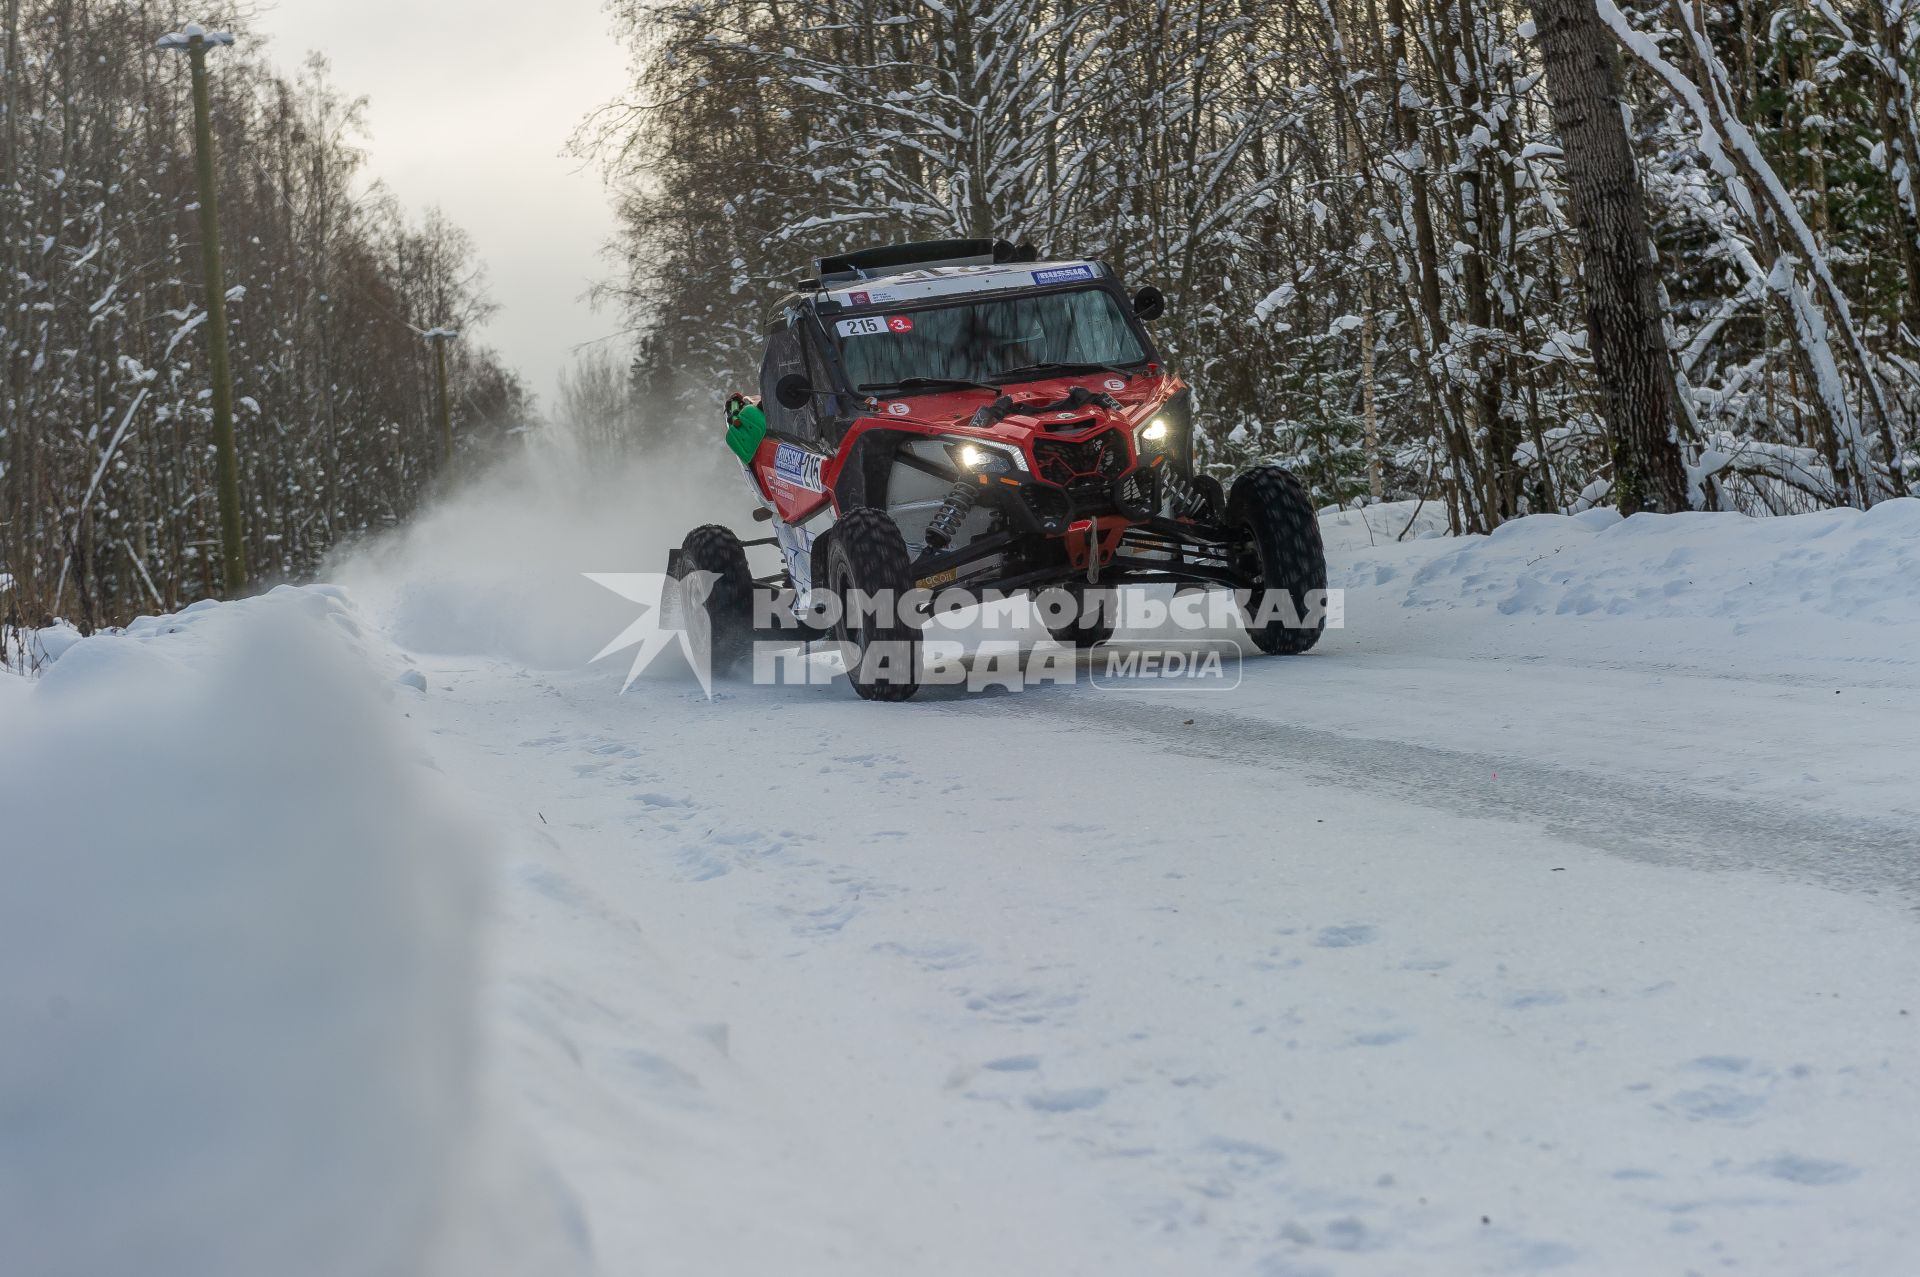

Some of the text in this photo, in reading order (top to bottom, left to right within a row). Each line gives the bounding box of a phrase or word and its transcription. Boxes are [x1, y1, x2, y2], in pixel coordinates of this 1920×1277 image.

[1039, 267, 1087, 279] RUSSIA
[847, 318, 877, 335] 215
[1109, 381, 1121, 389] E
[892, 405, 906, 414] E
[778, 447, 802, 467] RUSSIA
[800, 453, 819, 490] 215
